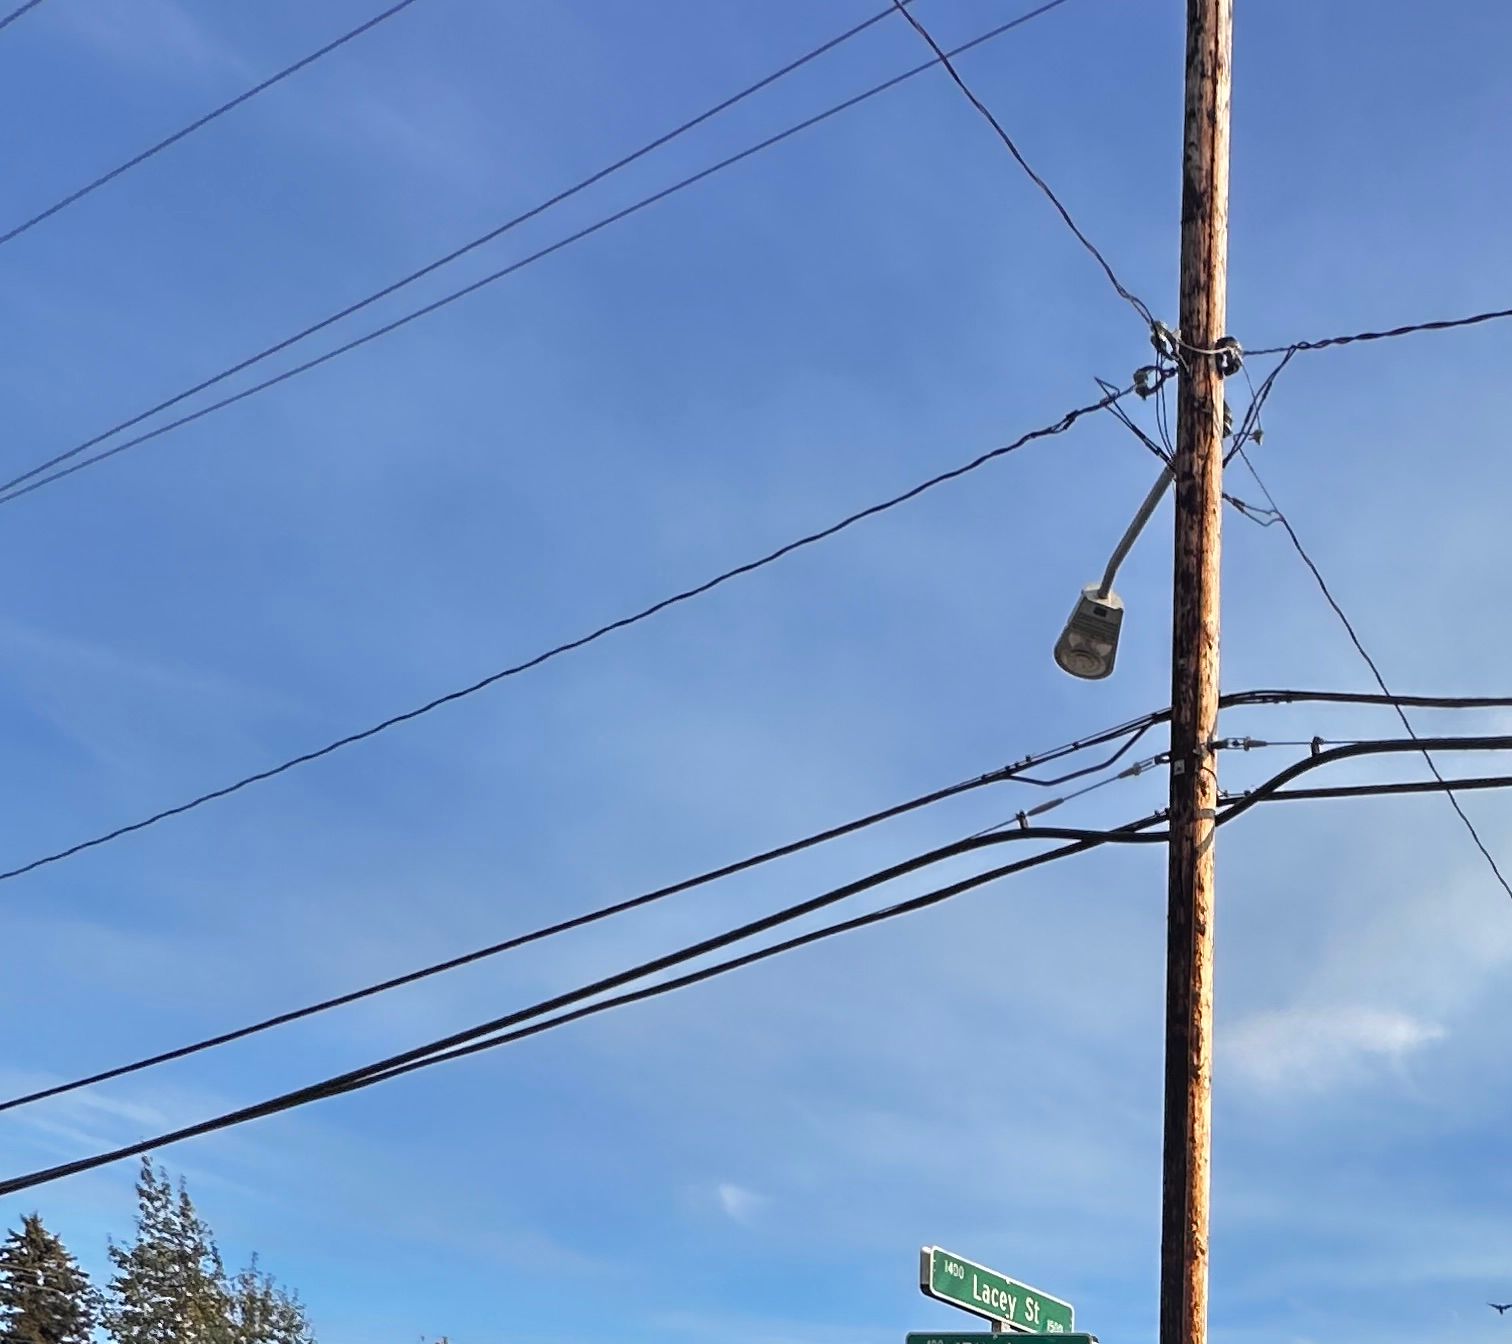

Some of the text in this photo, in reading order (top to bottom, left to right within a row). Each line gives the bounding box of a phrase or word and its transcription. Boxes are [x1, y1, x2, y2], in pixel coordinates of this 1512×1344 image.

[944, 1259, 965, 1280] 1400
[973, 1273, 1017, 1320] Lacey
[1024, 1296, 1040, 1325] St
